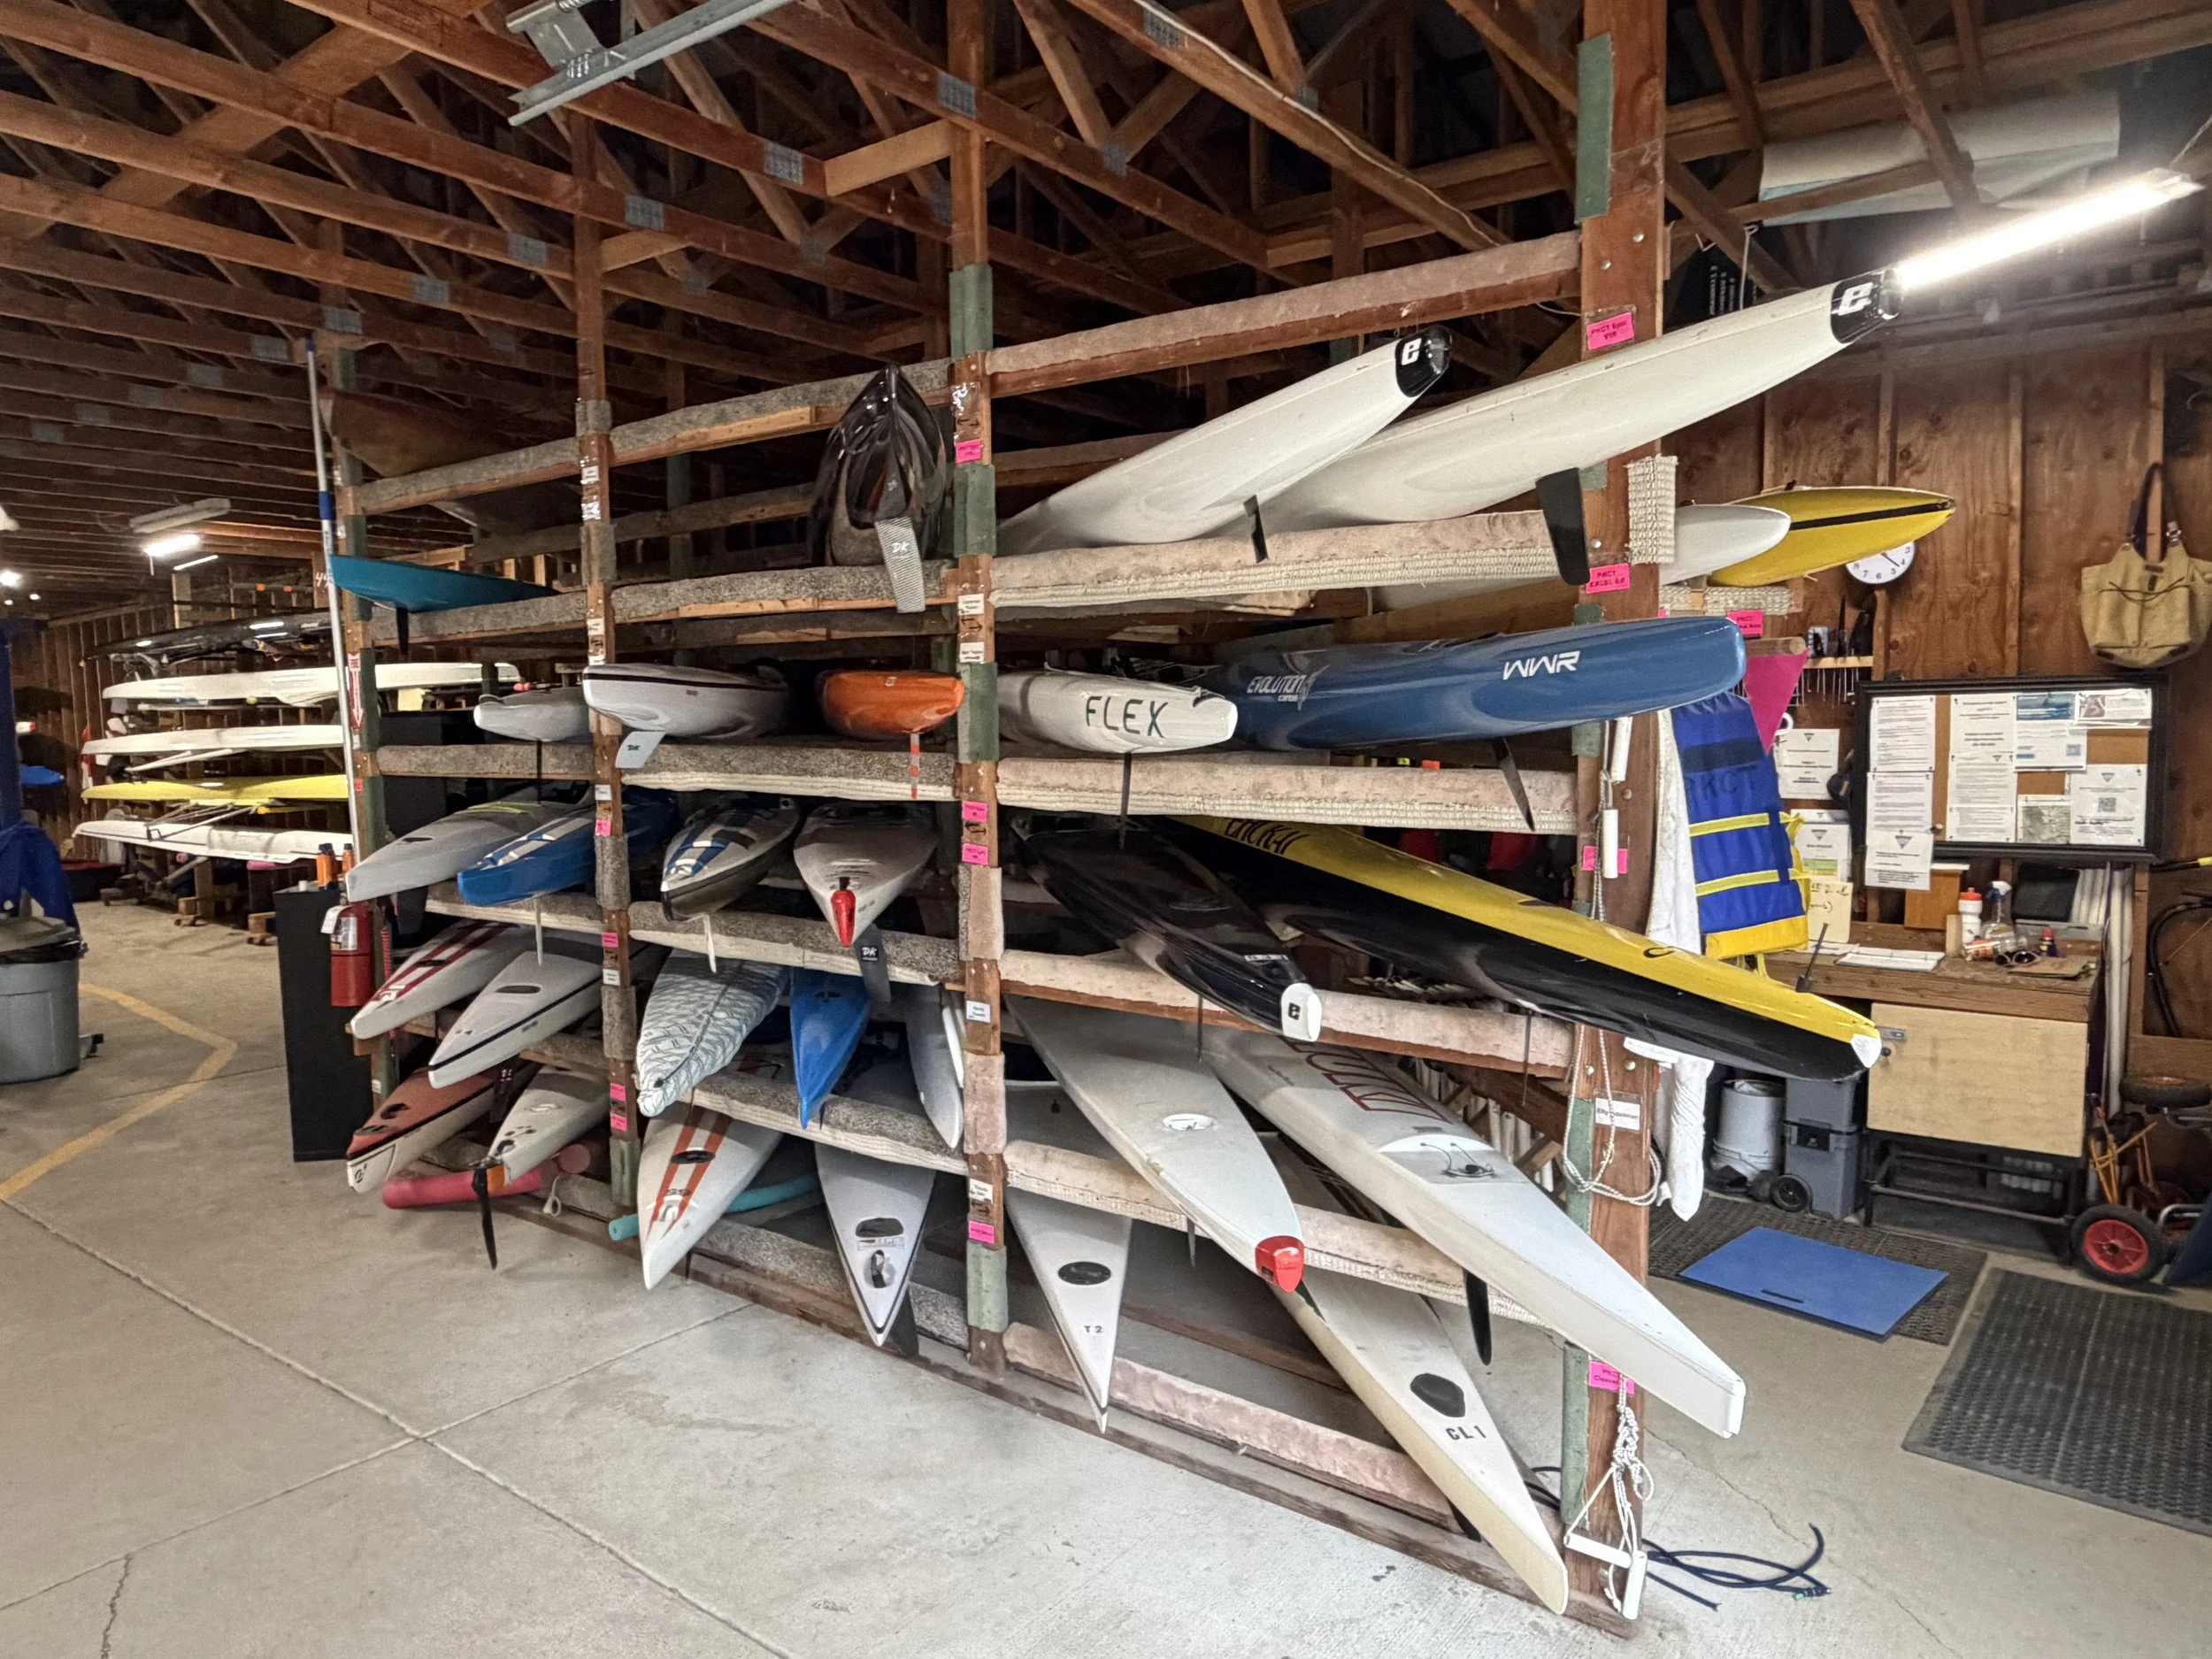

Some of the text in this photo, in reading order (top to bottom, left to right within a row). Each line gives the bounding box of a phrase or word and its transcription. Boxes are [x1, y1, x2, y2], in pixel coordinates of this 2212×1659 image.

[1502, 650, 1581, 680] WWR
[1247, 674, 1308, 694] EVOLUTION
[1085, 695, 1169, 739] FLEX
[861, 946, 878, 956] DK
